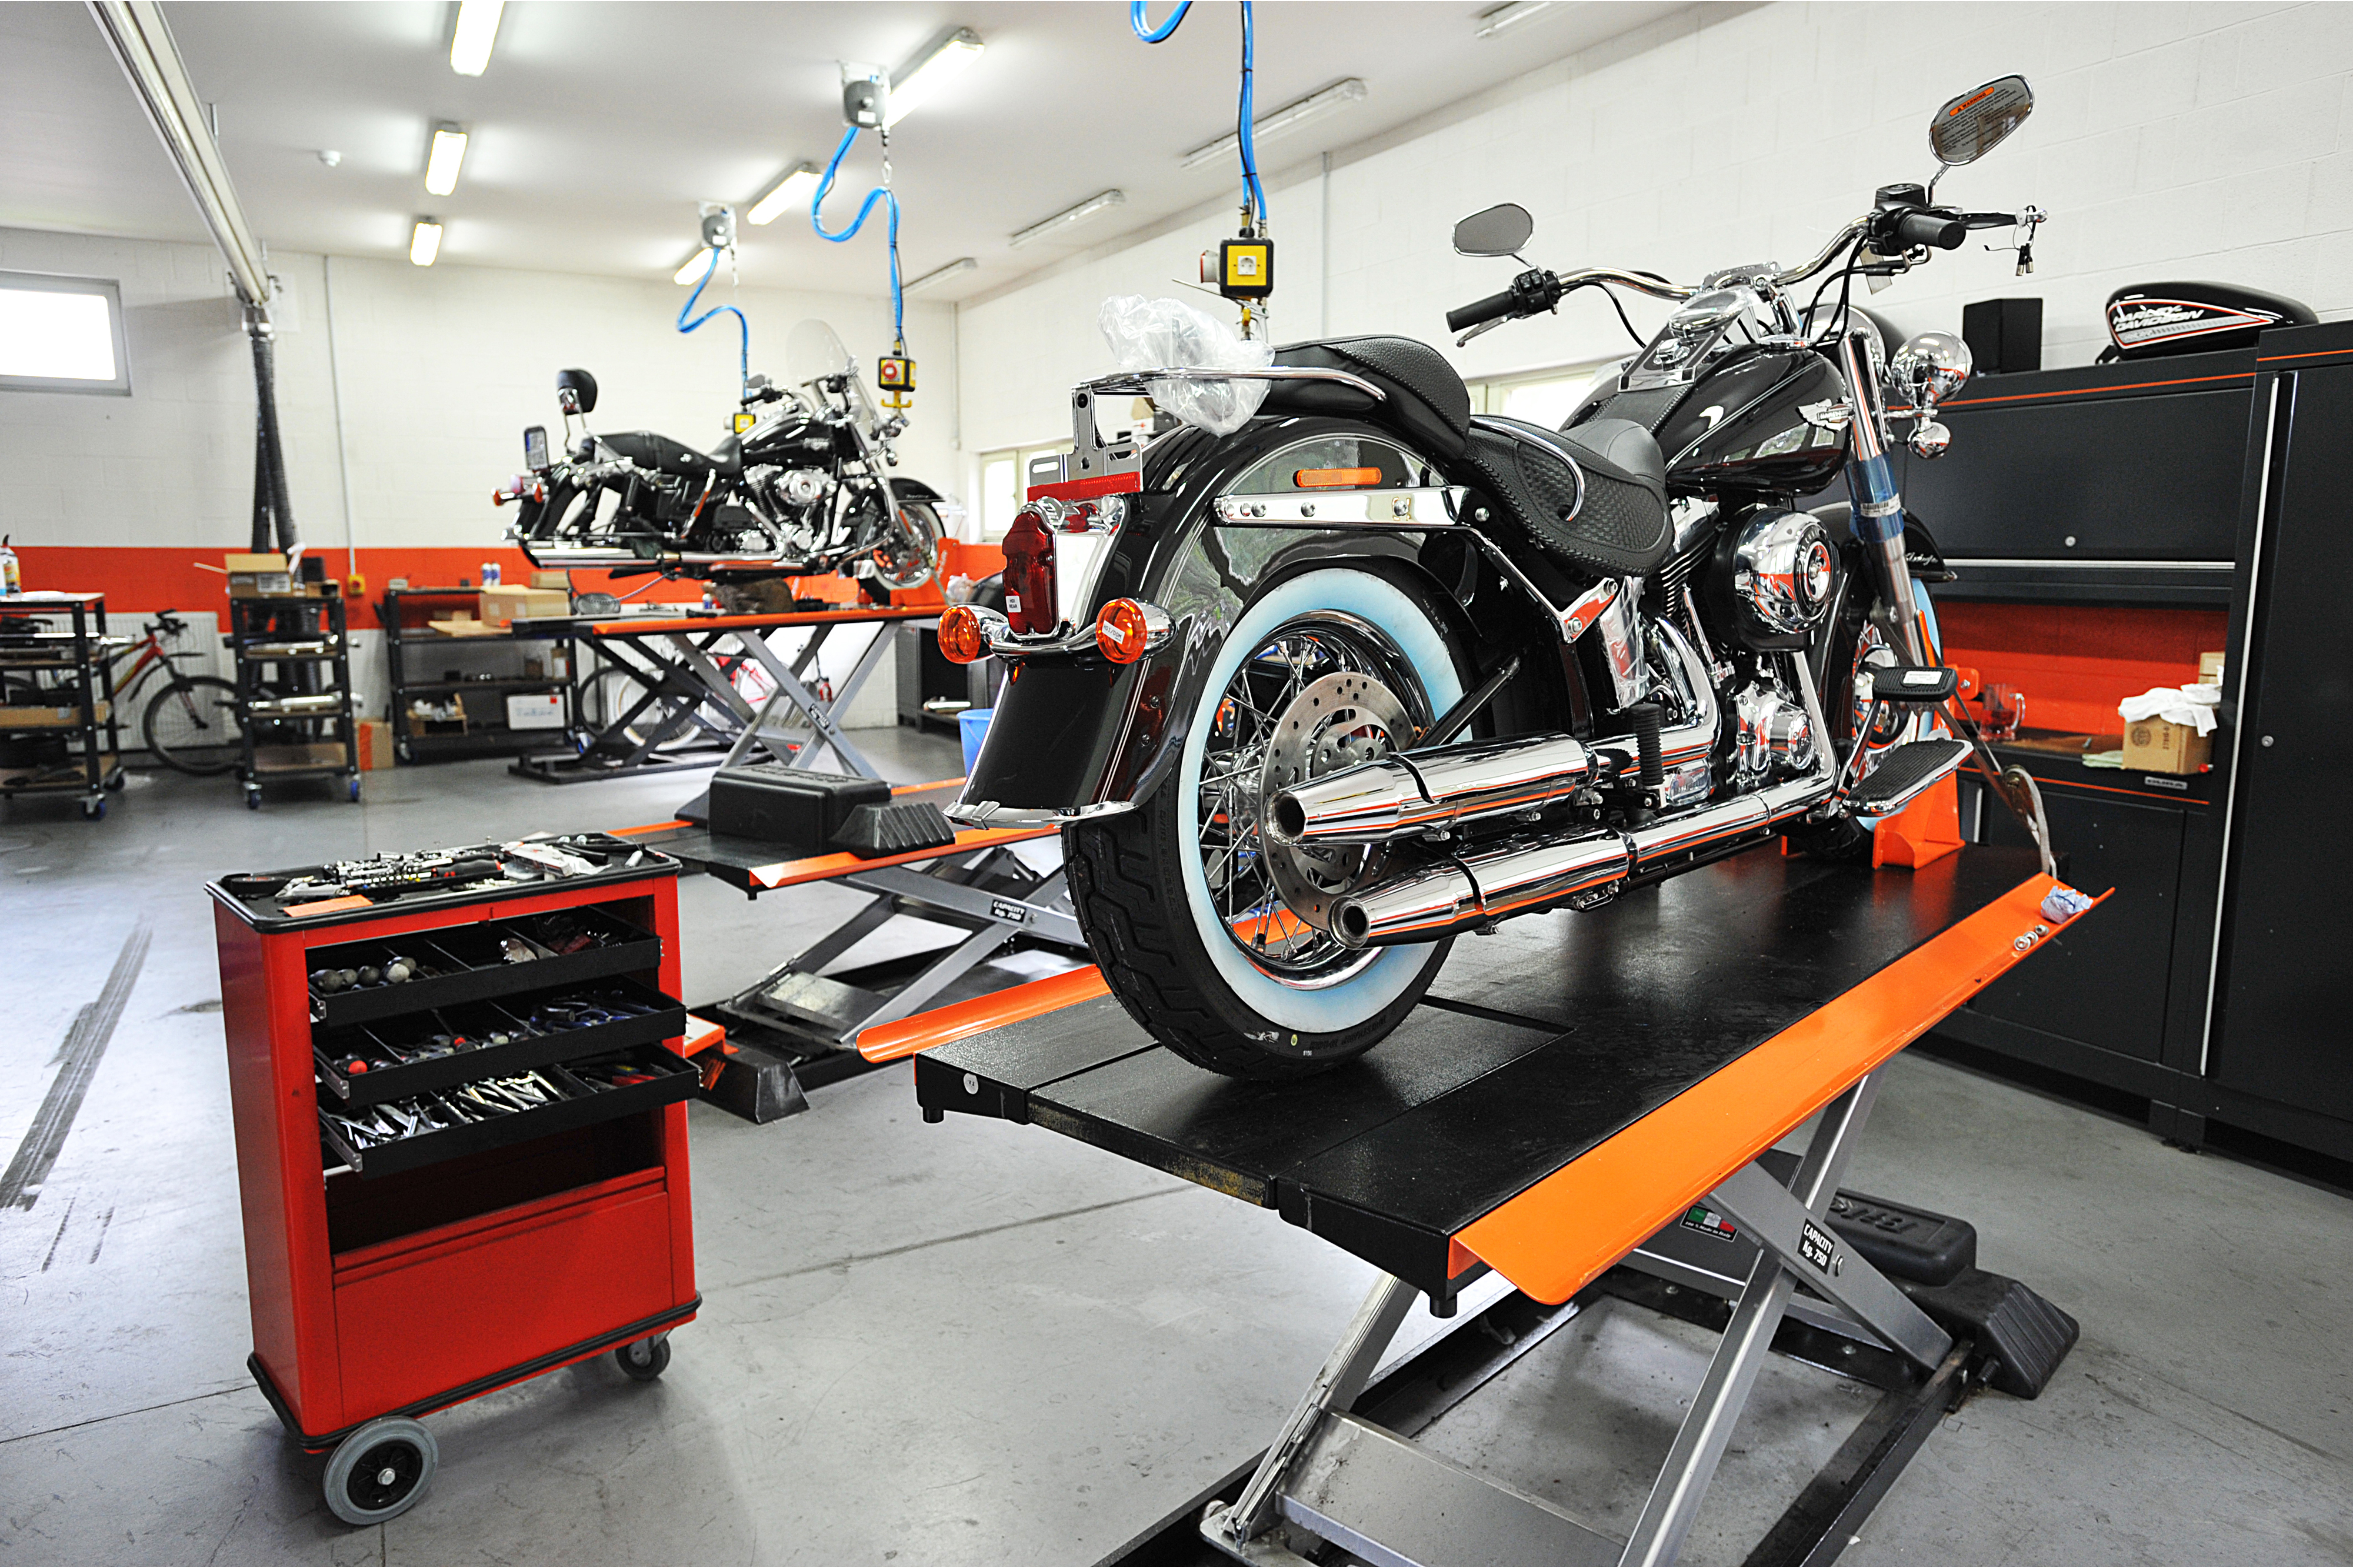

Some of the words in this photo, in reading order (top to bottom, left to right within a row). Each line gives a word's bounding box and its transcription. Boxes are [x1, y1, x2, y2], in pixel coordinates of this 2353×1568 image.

[1962, 92, 1987, 108] WARNING
[2115, 309, 2204, 332] DAVIDSON
[994, 901, 1025, 914] CAPACITY
[1804, 1223, 1834, 1255] CAPACITY
[1802, 1240, 1818, 1256] Kg.
[1812, 1247, 1828, 1267] 750
